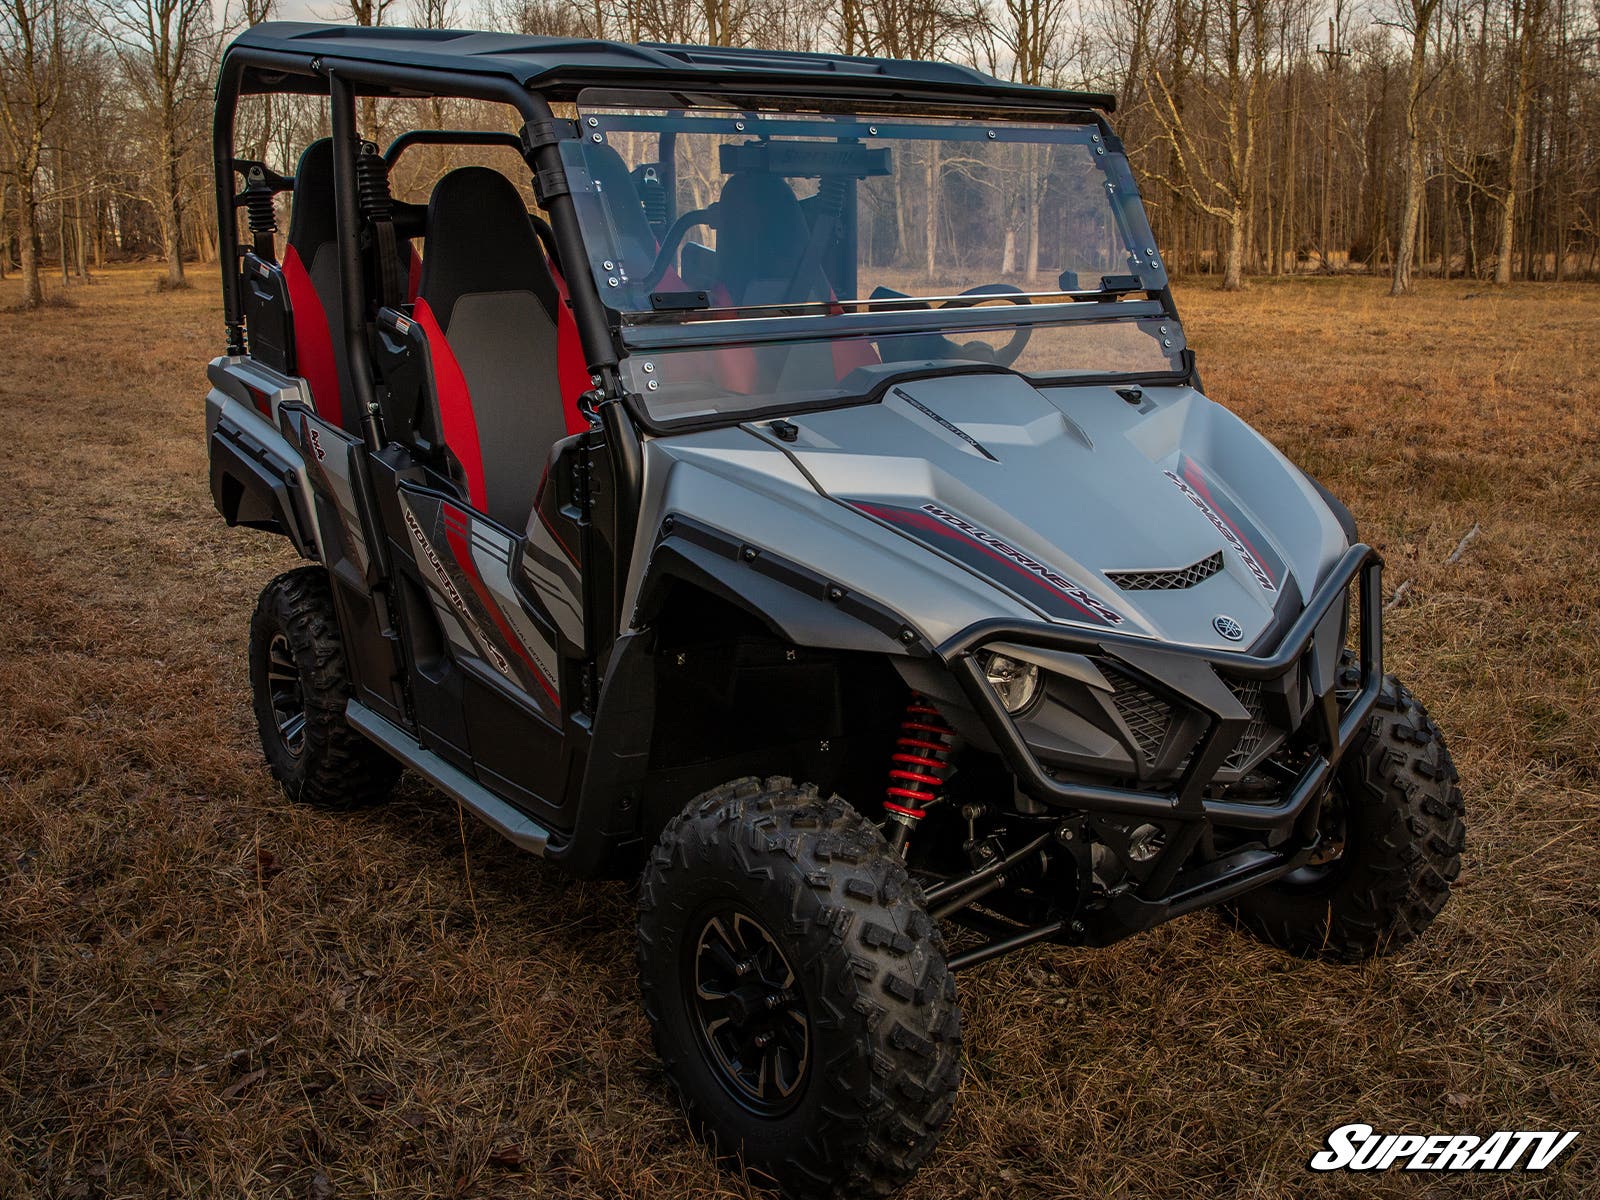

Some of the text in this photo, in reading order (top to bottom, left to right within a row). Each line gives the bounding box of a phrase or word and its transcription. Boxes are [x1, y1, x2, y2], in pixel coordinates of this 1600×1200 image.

[920, 503, 1125, 625] WOLVERINE X4
[479, 631, 509, 673] X4
